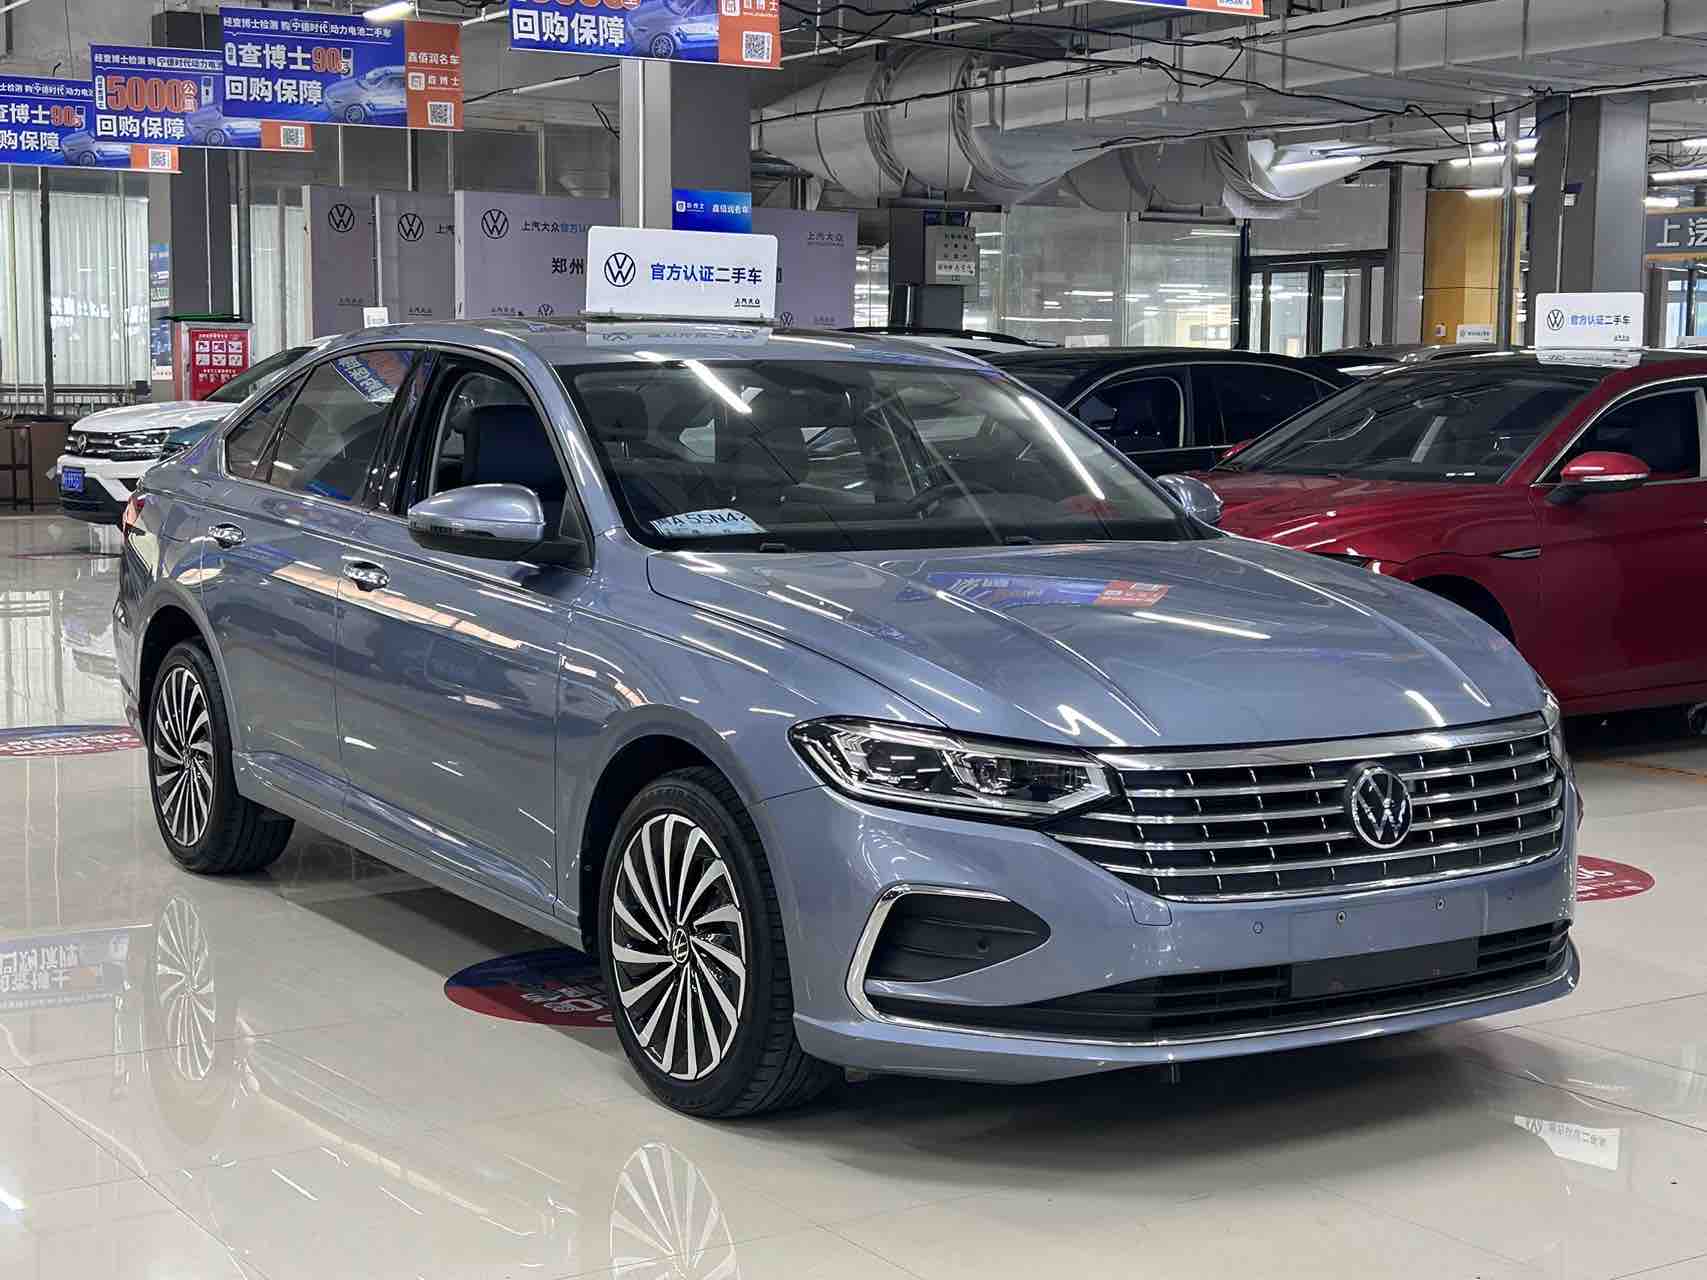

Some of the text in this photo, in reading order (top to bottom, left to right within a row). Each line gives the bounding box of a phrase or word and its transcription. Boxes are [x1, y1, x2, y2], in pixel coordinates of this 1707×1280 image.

[512, 9, 625, 48] 回购保障
[225, 75, 324, 105] 回购保障
[96, 114, 186, 141] 回购保障
[552, 257, 583, 275] 郑州
[651, 262, 762, 285] 官方认证二手车
